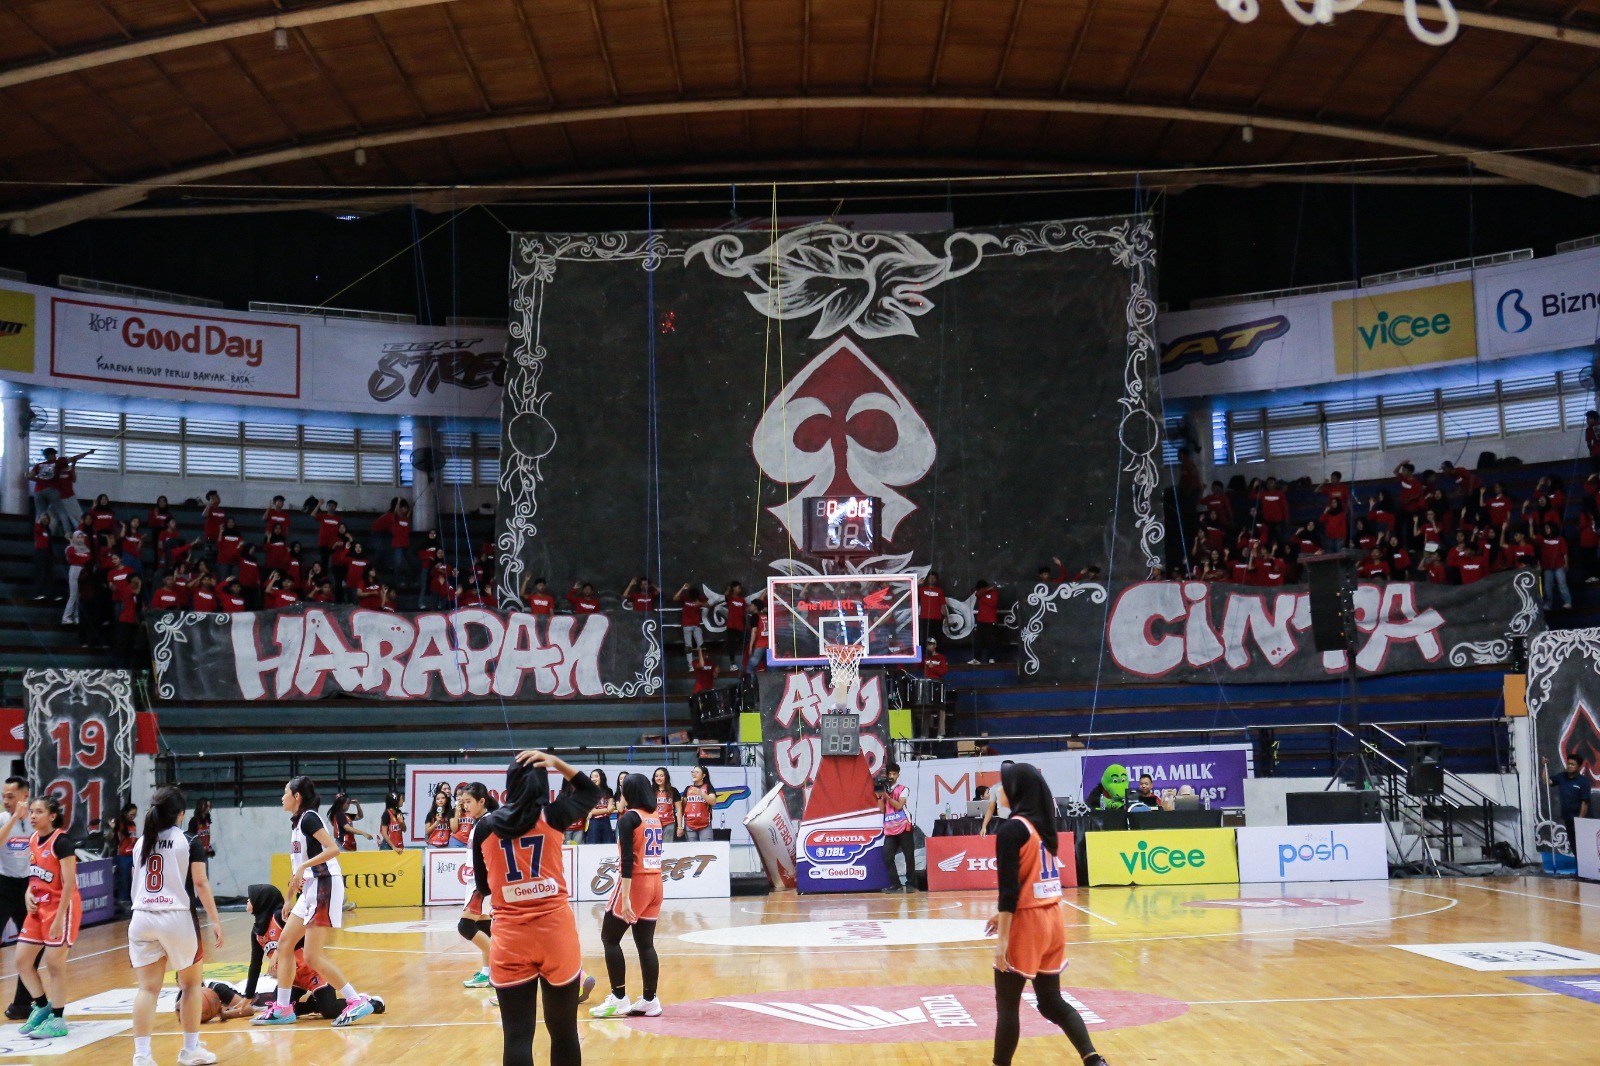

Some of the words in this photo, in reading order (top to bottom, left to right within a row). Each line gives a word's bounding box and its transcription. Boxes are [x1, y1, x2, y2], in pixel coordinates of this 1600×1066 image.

[1542, 292, 1600, 317] Bizn
[381, 338, 484, 353] BEAT
[1160, 315, 1291, 374] AT
[96, 356, 134, 374] KARENA
[137, 366, 162, 377] HIDUP
[165, 369, 190, 379] PERLU
[193, 371, 225, 382] BANYAK
[230, 375, 250, 384] RASA
[797, 600, 817, 611] One
[230, 608, 610, 701] HARAPAN
[48, 717, 107, 769] 19
[1126, 763, 1167, 783] LTRA
[1169, 762, 1214, 782] MILK
[645, 828, 663, 855] 25
[772, 813, 793, 846] CREAM
[825, 835, 867, 843] HONDA
[158, 840, 174, 849] YAN
[825, 846, 846, 857] DBL
[1279, 830, 1349, 877] posh
[500, 835, 544, 882] 17
[145, 853, 164, 892] 8
